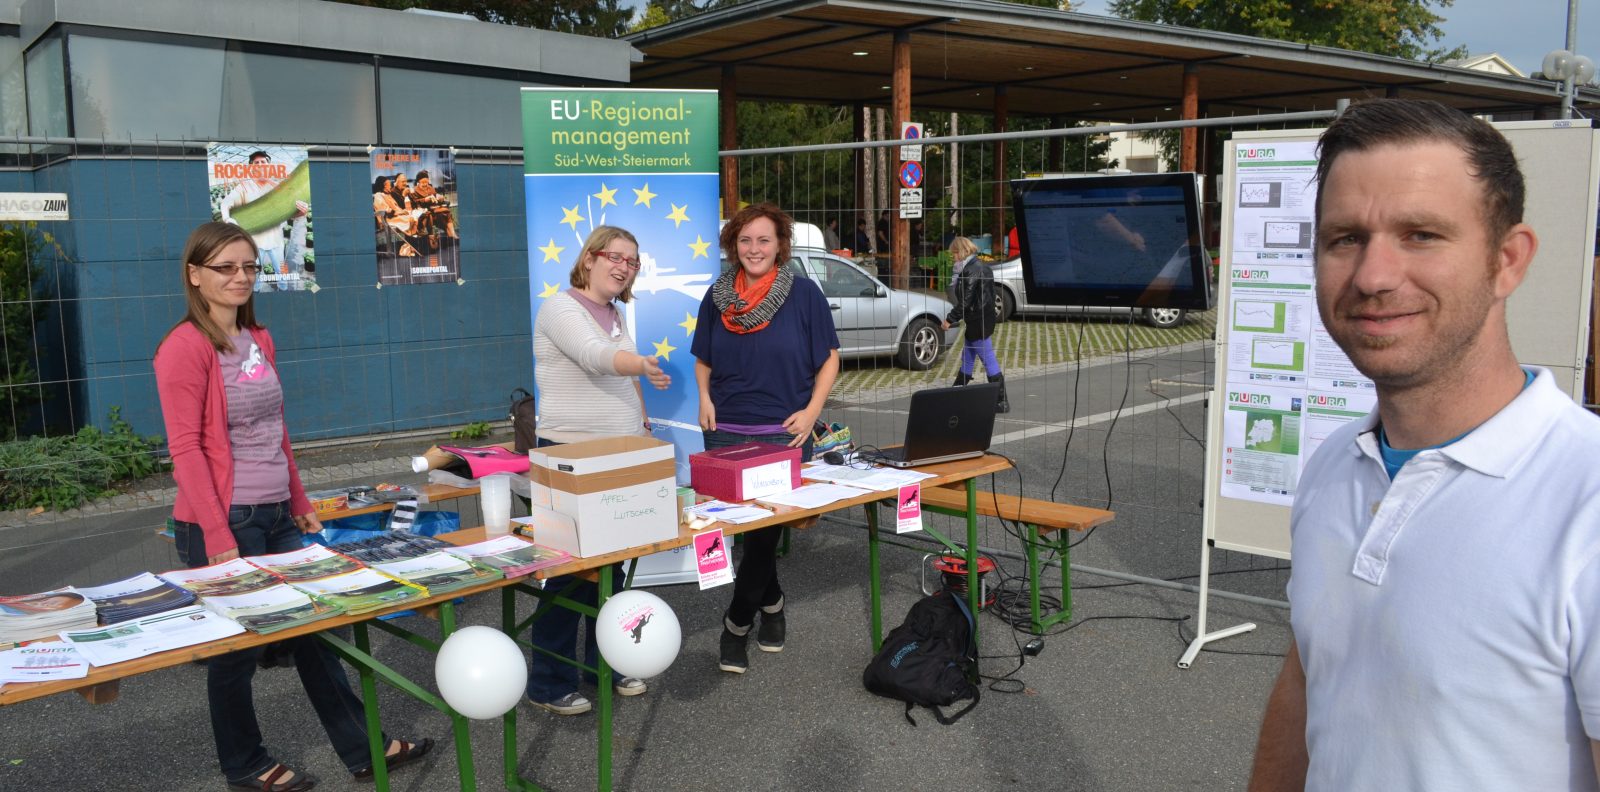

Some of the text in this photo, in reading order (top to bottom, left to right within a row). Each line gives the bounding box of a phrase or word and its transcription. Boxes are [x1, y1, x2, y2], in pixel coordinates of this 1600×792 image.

[550, 98, 692, 126] EU-Regional-
[551, 127, 691, 150] management
[554, 152, 692, 167] Süd-West-Steiermark
[1238, 148, 1275, 158] YURA
[1232, 269, 1269, 280] YURA
[1229, 391, 1271, 405] YURA
[1308, 395, 1347, 407] YURA
